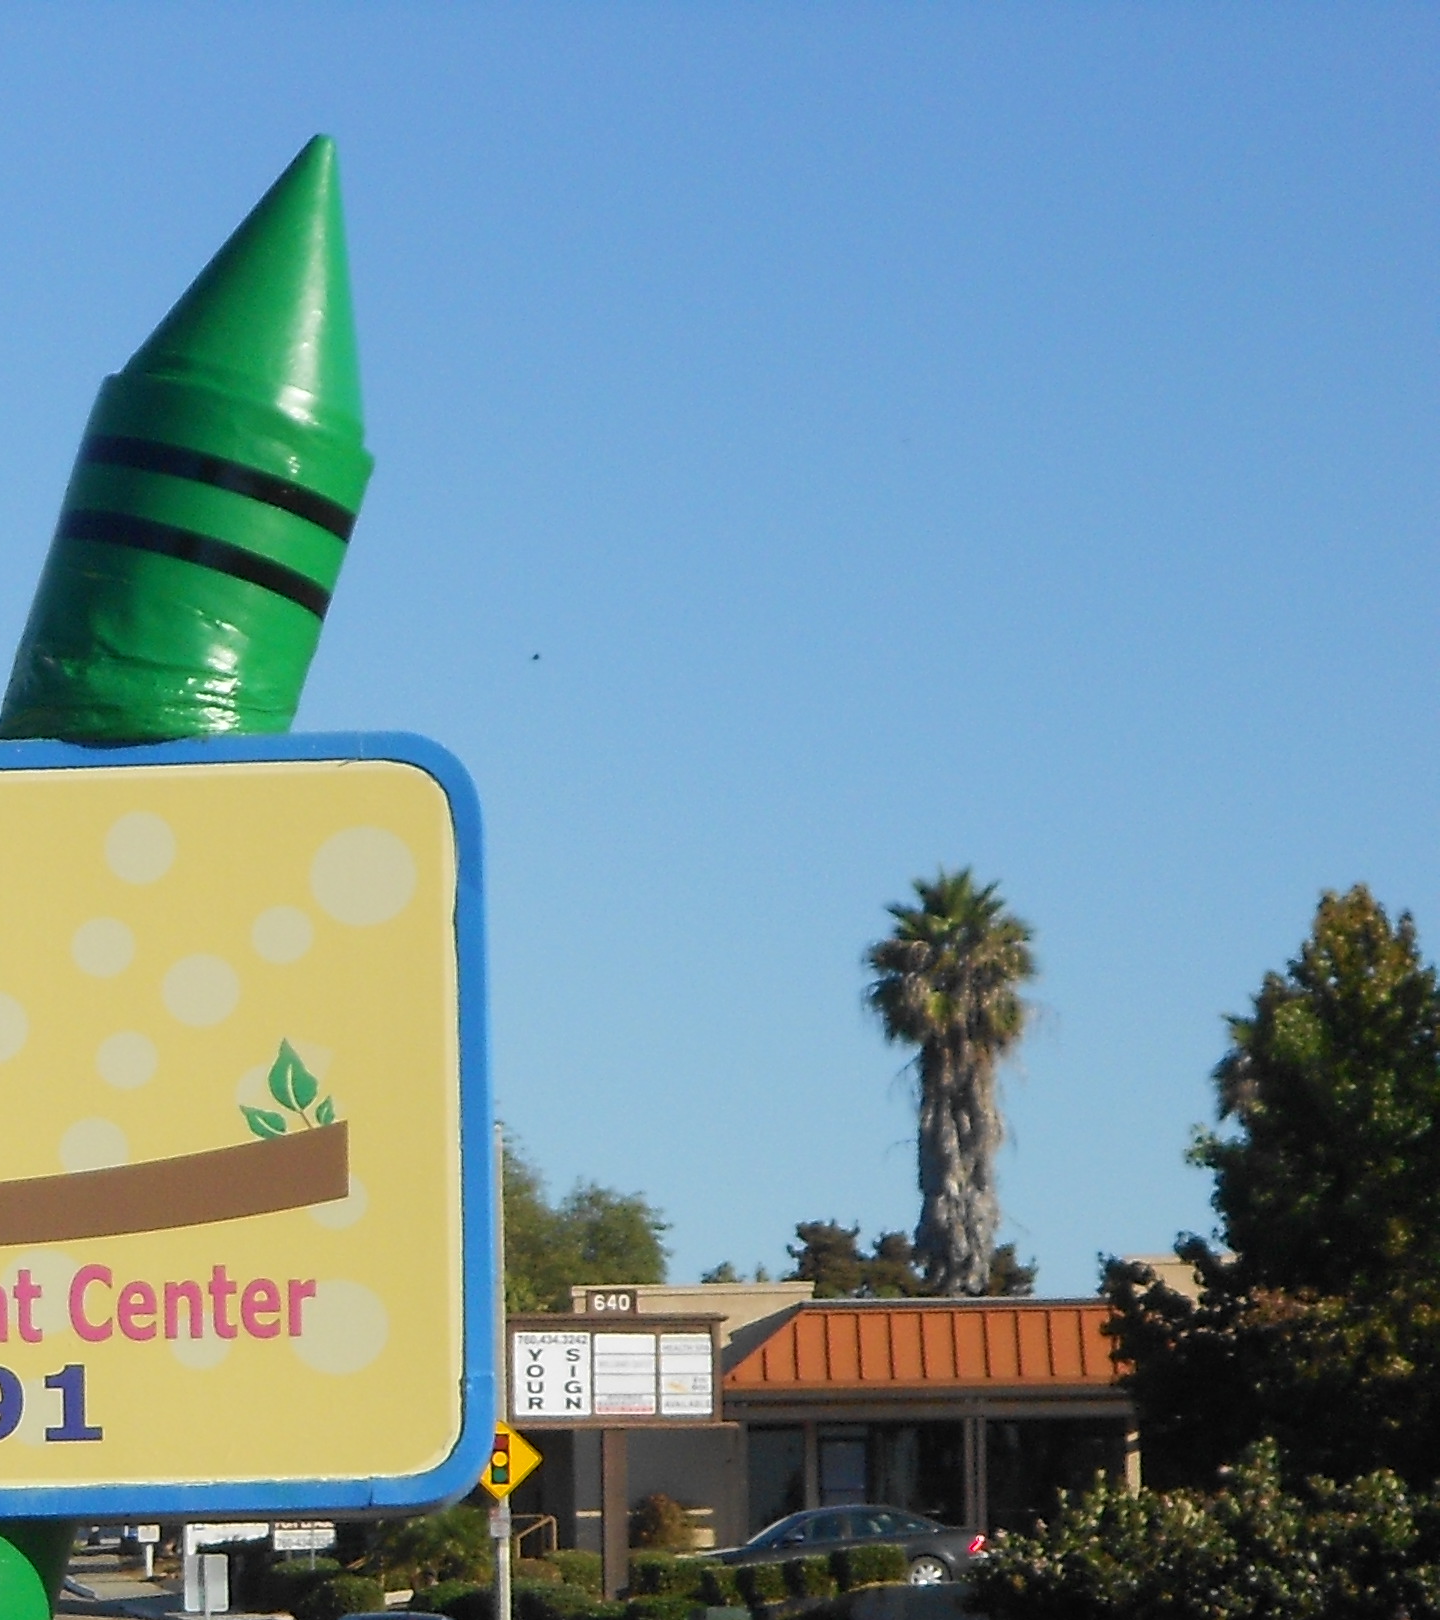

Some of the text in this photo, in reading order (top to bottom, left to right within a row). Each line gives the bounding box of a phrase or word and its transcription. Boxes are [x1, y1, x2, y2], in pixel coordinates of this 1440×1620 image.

[69, 1263, 317, 1342] Center
[594, 1294, 630, 1311] 640
[527, 1348, 544, 1410] YOUR
[564, 1348, 582, 1410] SIGN
